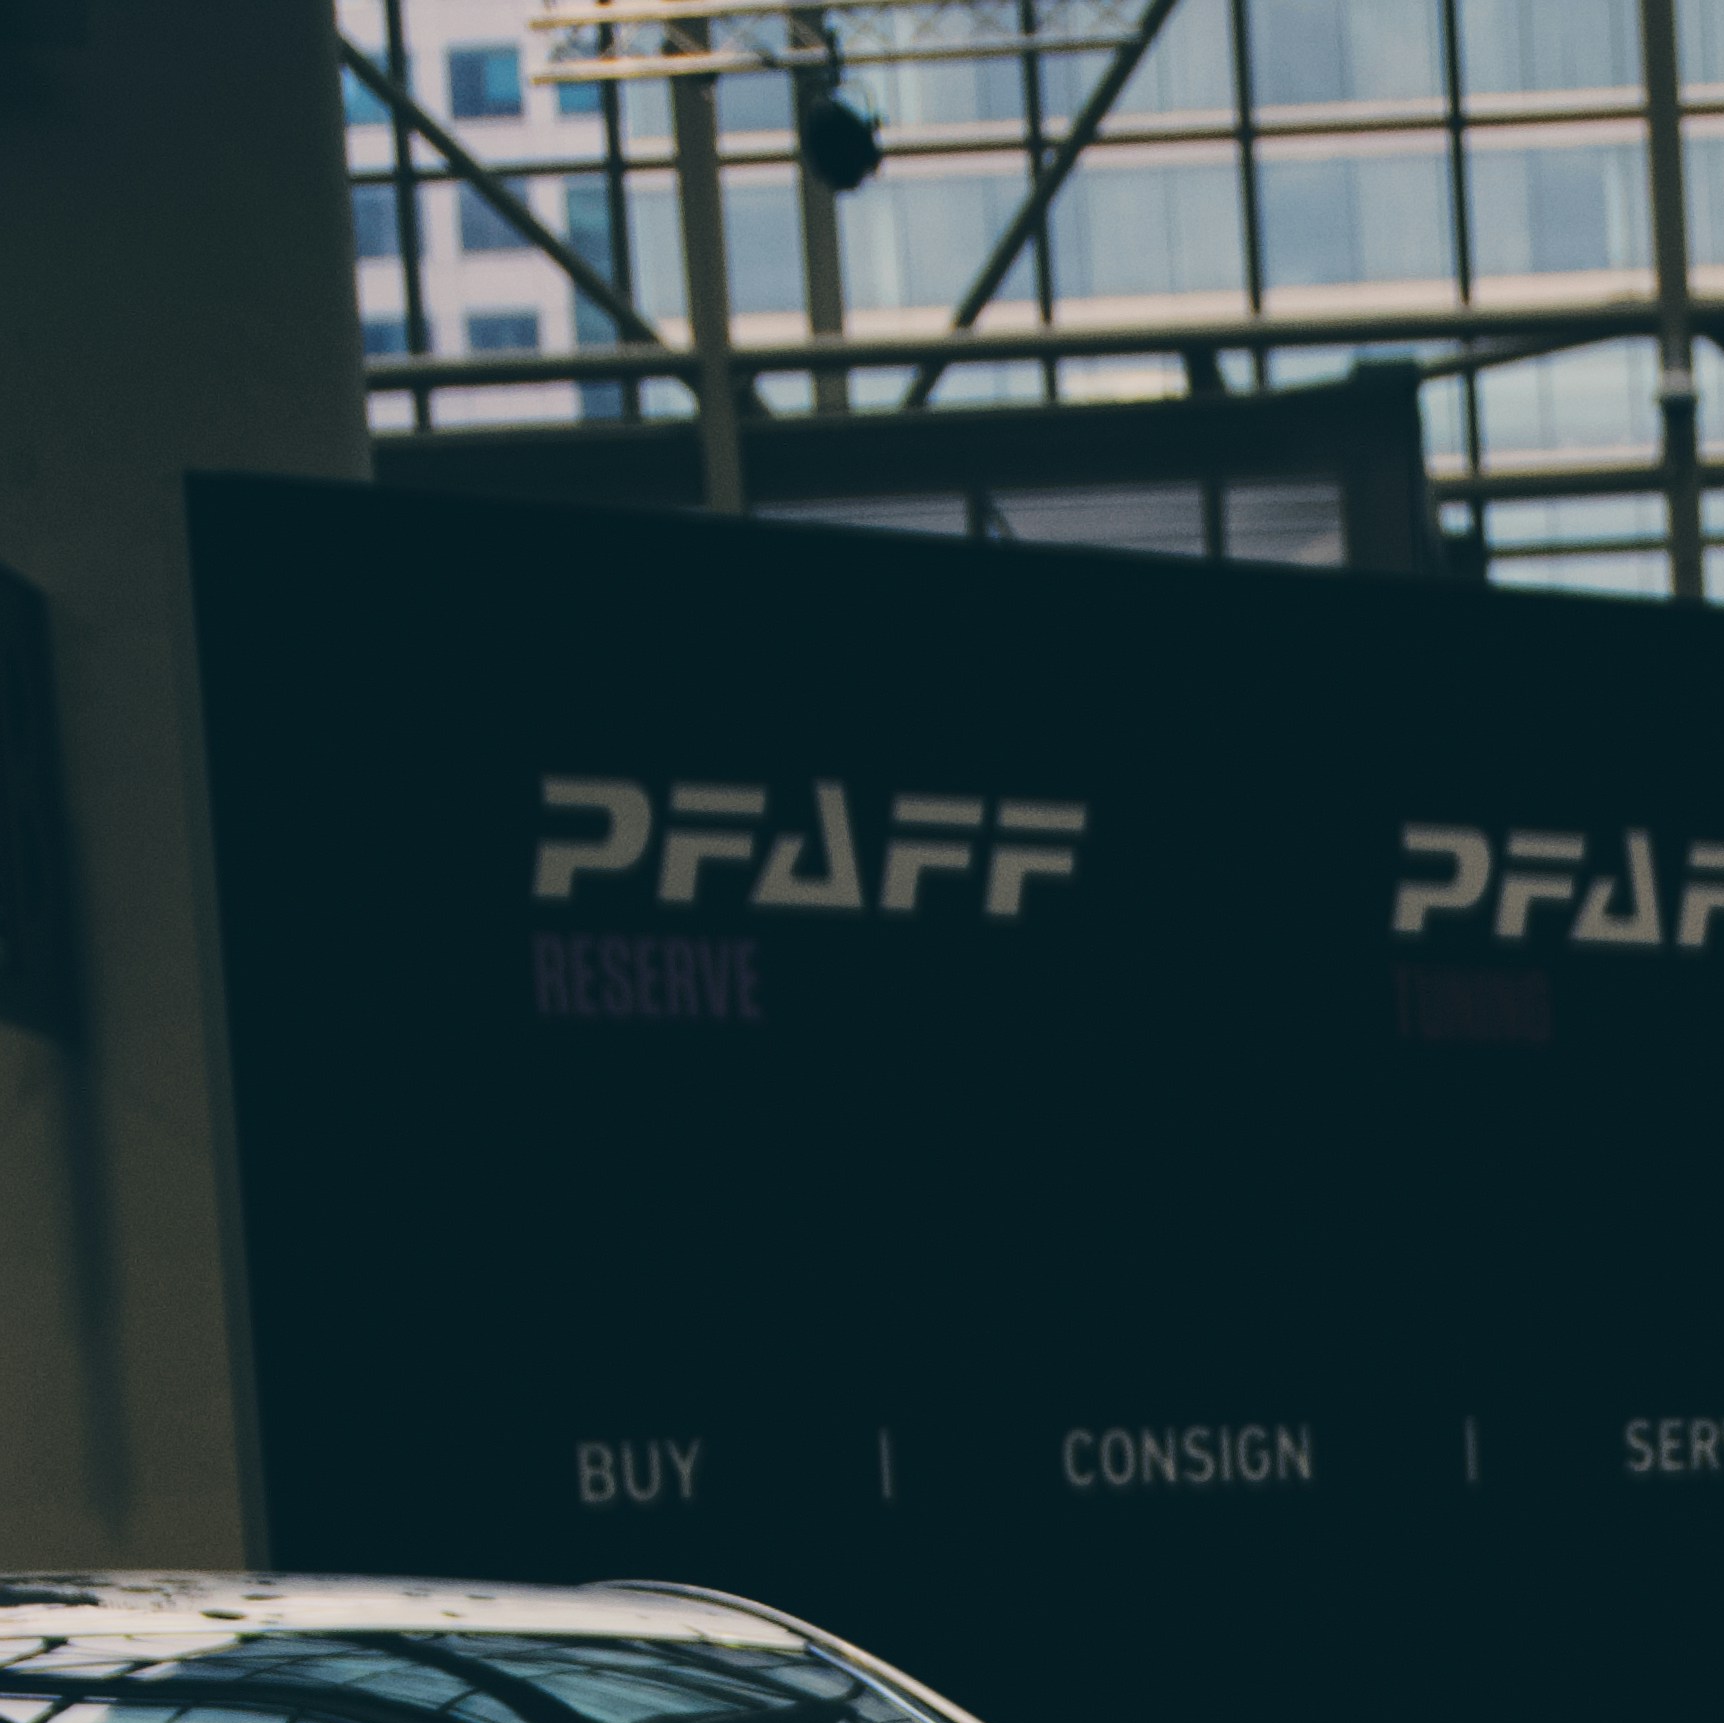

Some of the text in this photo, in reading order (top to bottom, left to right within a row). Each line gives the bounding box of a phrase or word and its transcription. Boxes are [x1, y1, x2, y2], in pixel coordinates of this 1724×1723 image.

[534, 777, 1087, 917] PFAFF
[532, 932, 762, 1020] RESERVE
[577, 1441, 700, 1505] BUY
[1063, 1424, 1313, 1488] CONSIGN
